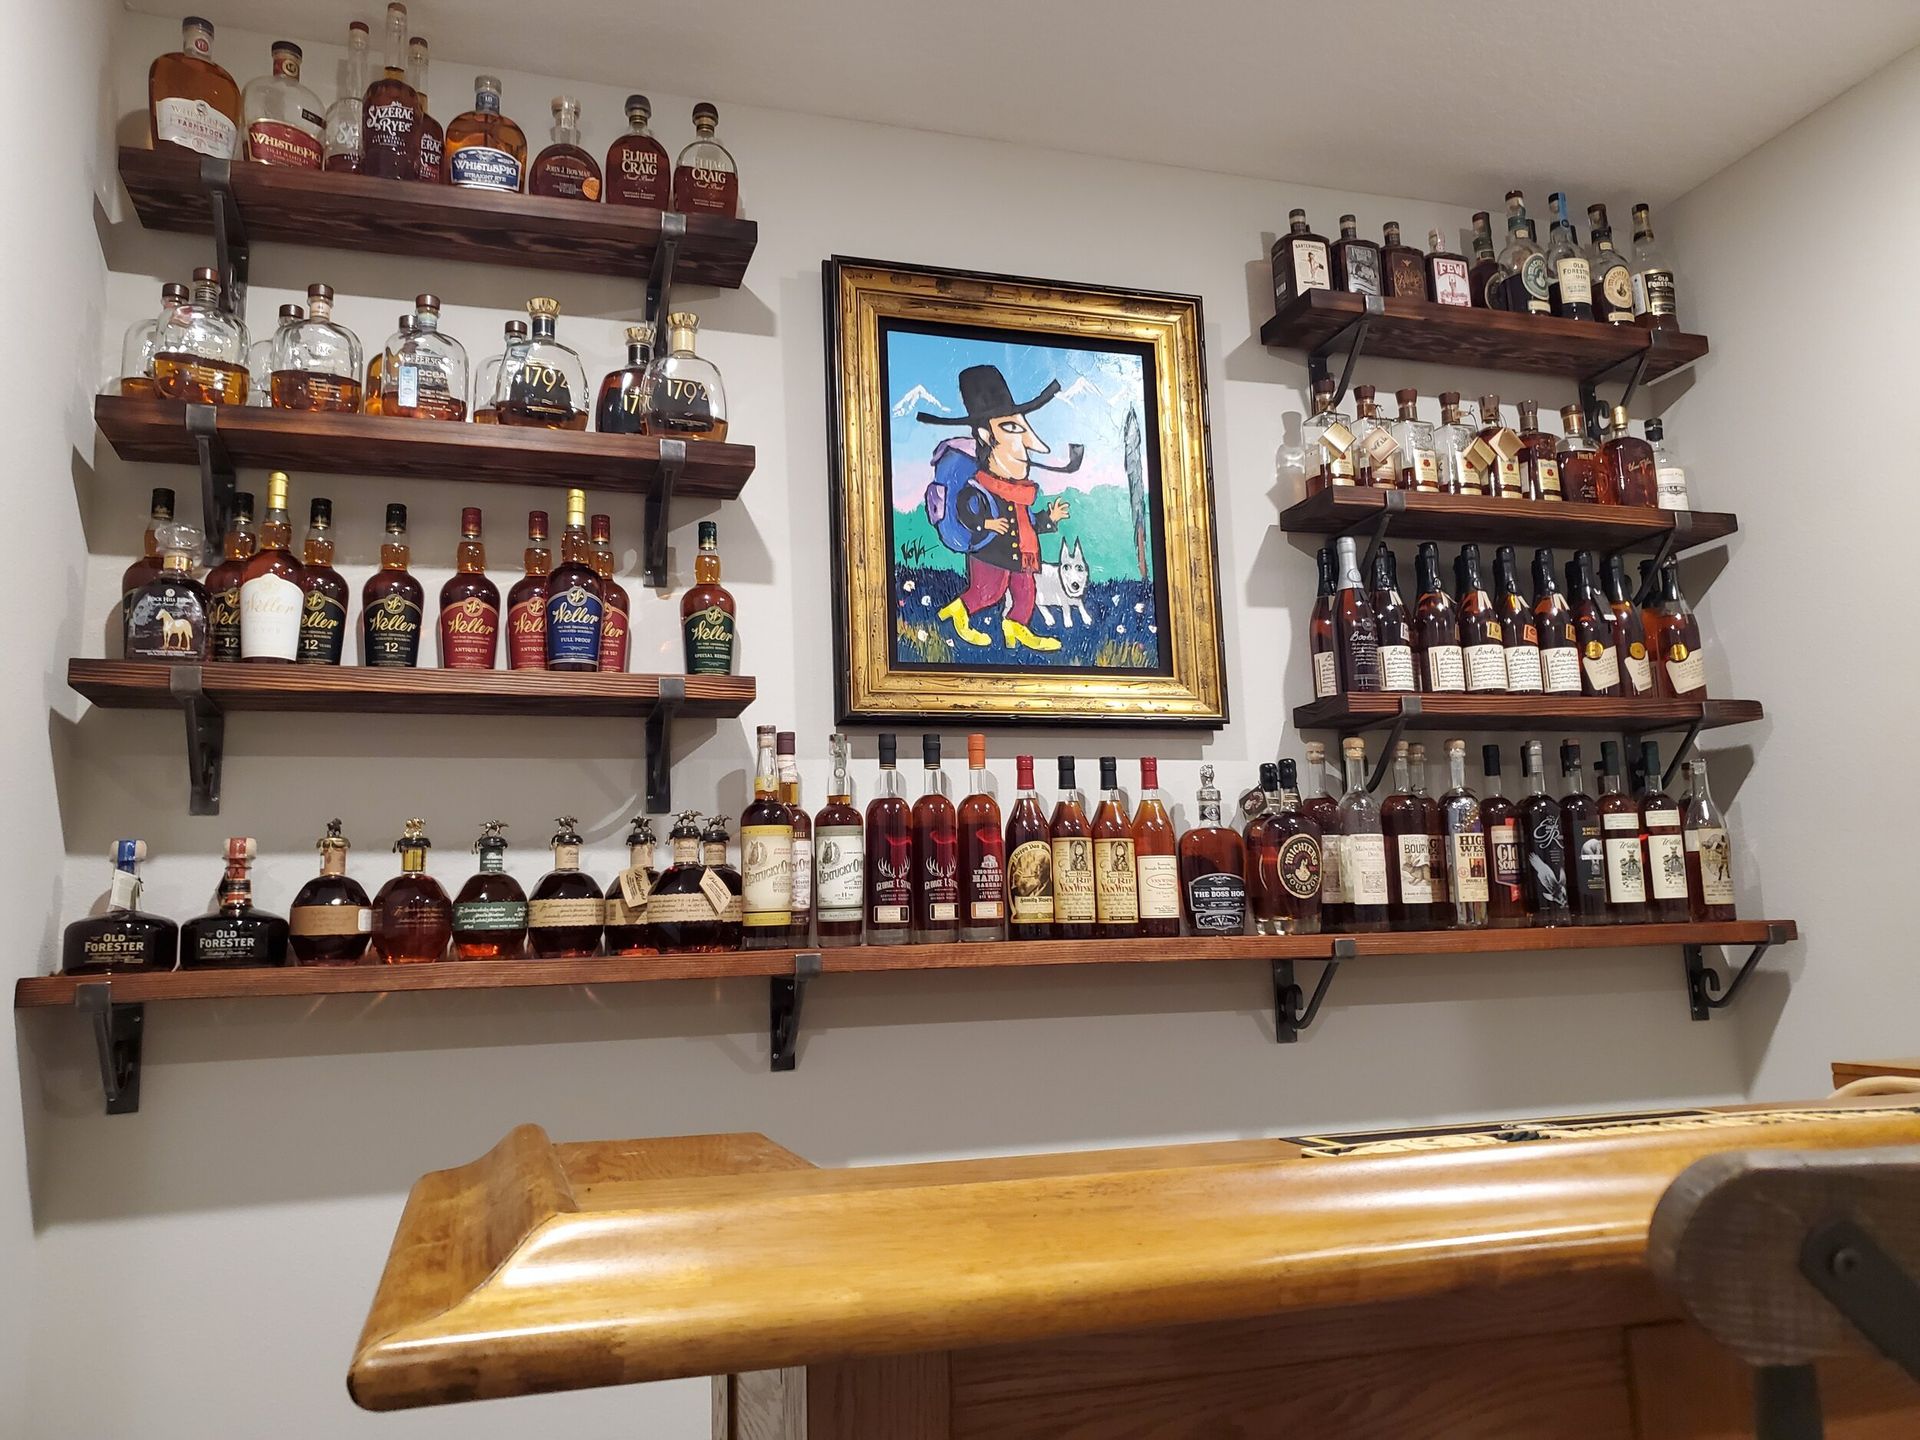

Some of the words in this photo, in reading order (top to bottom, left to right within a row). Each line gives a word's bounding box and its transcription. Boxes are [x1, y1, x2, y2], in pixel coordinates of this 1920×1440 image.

[367, 104, 414, 128] SAZERAC
[622, 149, 657, 164] ELIJAH
[621, 160, 657, 175] CRAIG
[691, 167, 727, 184] CRAIG
[525, 365, 570, 393] 1792
[666, 379, 709, 405] 1792
[209, 603, 241, 625] Well
[301, 611, 338, 629] eller
[369, 609, 417, 633] Weller
[552, 601, 599, 625] Weller
[447, 612, 495, 635] Weller
[513, 612, 544, 634] Well
[691, 619, 734, 642] Weller
[224, 638, 239, 648] 12
[304, 639, 319, 650] 12
[384, 642, 399, 653] 12
[1460, 845, 1485, 853] WES
[819, 862, 854, 885] KENTUCKY
[1498, 861, 1519, 870] SCOU
[1286, 873, 1320, 892] BOURBON
[103, 933, 126, 942] OLD
[215, 929, 237, 938] OLD
[84, 942, 145, 952] FORESTER
[199, 937, 256, 948] FORESTER
